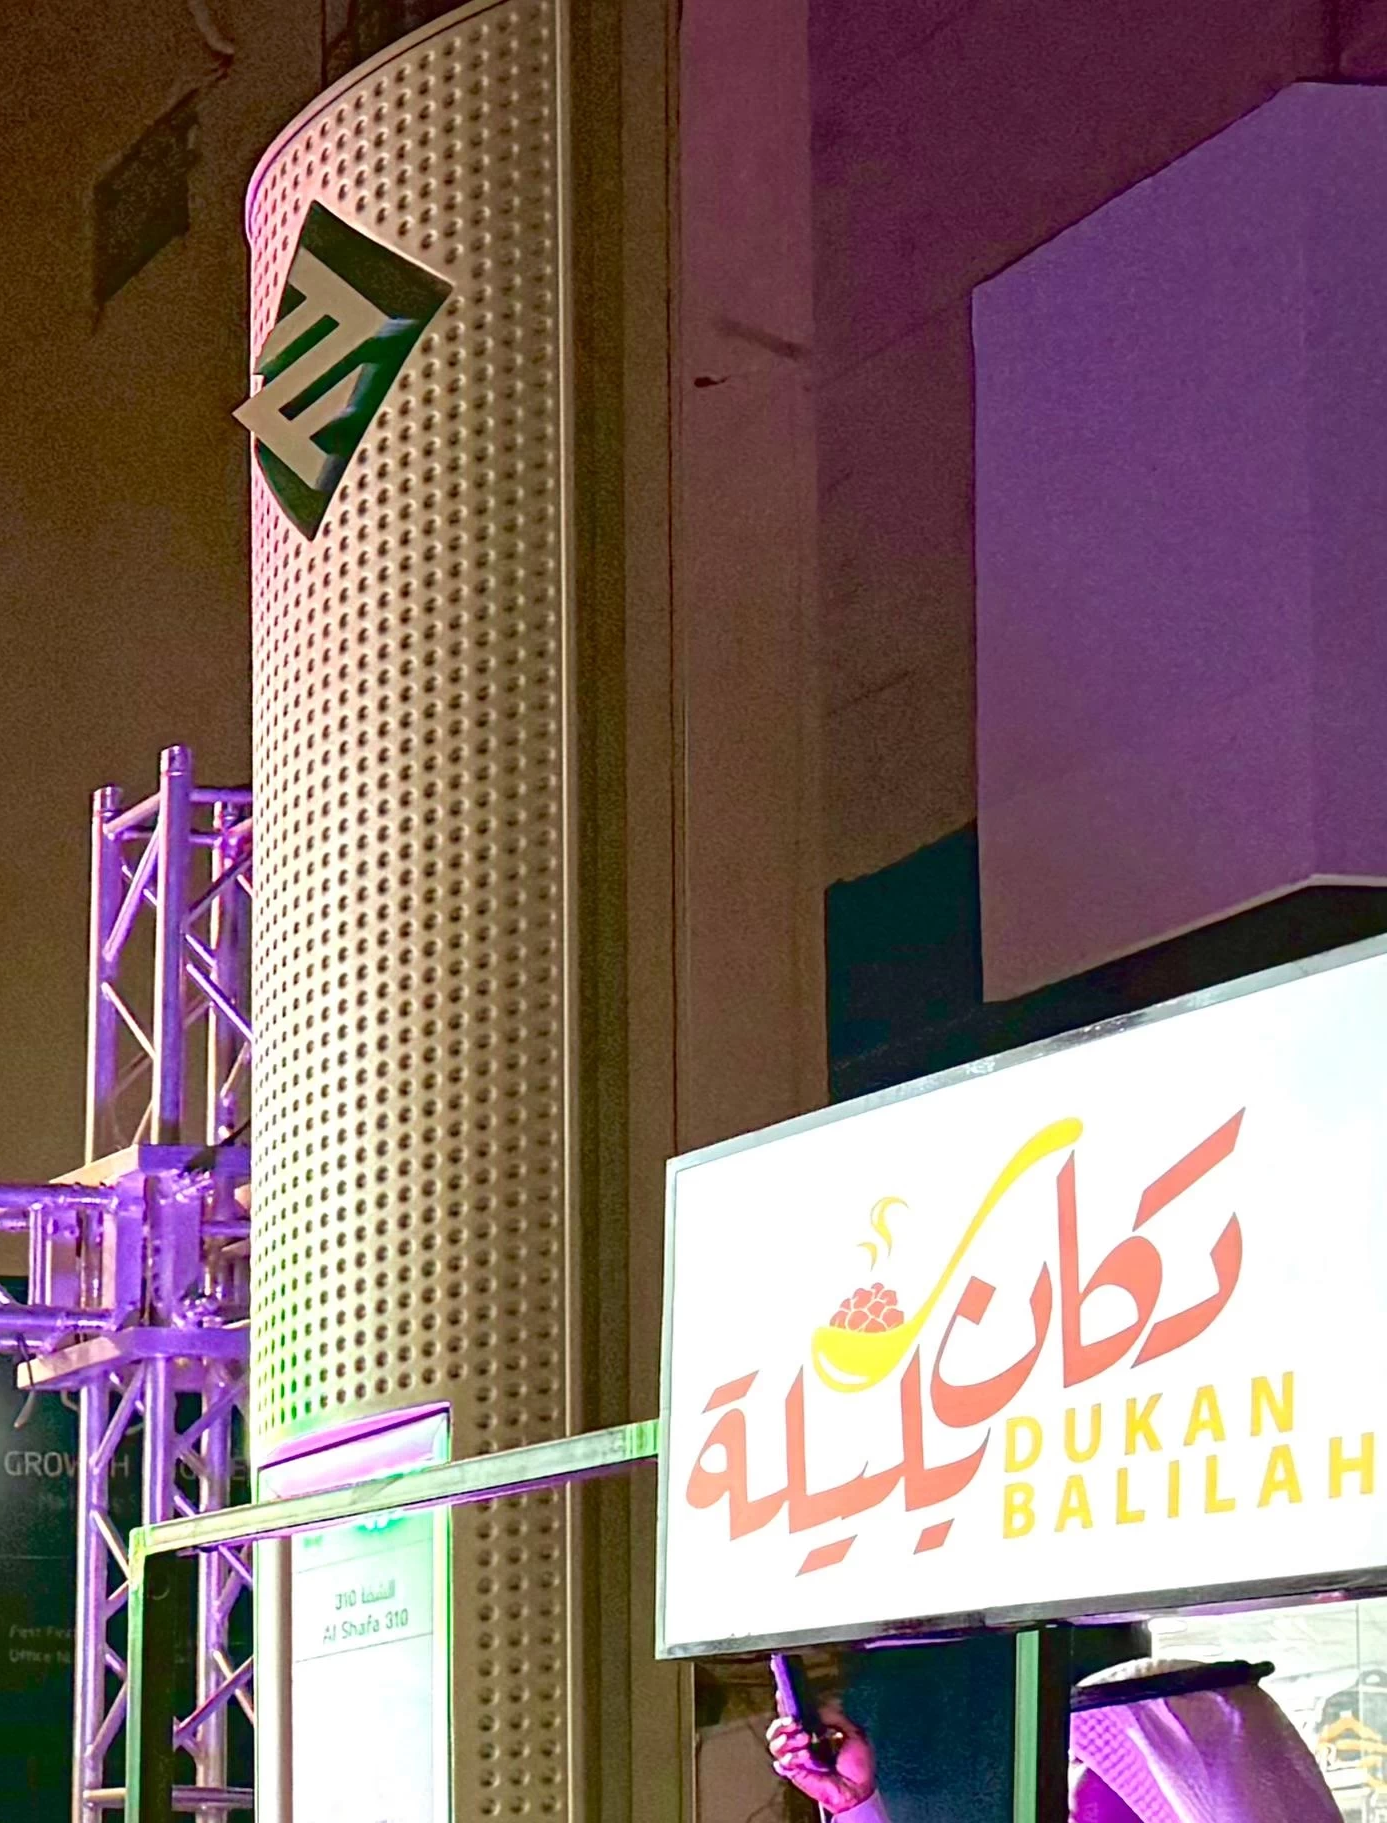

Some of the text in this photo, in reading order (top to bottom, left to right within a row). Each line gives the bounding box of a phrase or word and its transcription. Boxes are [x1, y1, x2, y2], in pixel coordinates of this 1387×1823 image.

[929, 1106, 1246, 1428] دكان
[4, 1450, 129, 1478] GROH
[685, 1343, 991, 1578] بليلة
[1004, 1371, 1295, 1474] DUKAN
[1002, 1431, 1375, 1541] BALILAH
[342, 1614, 380, 1639] Shafa
[385, 1608, 409, 1630] 310
